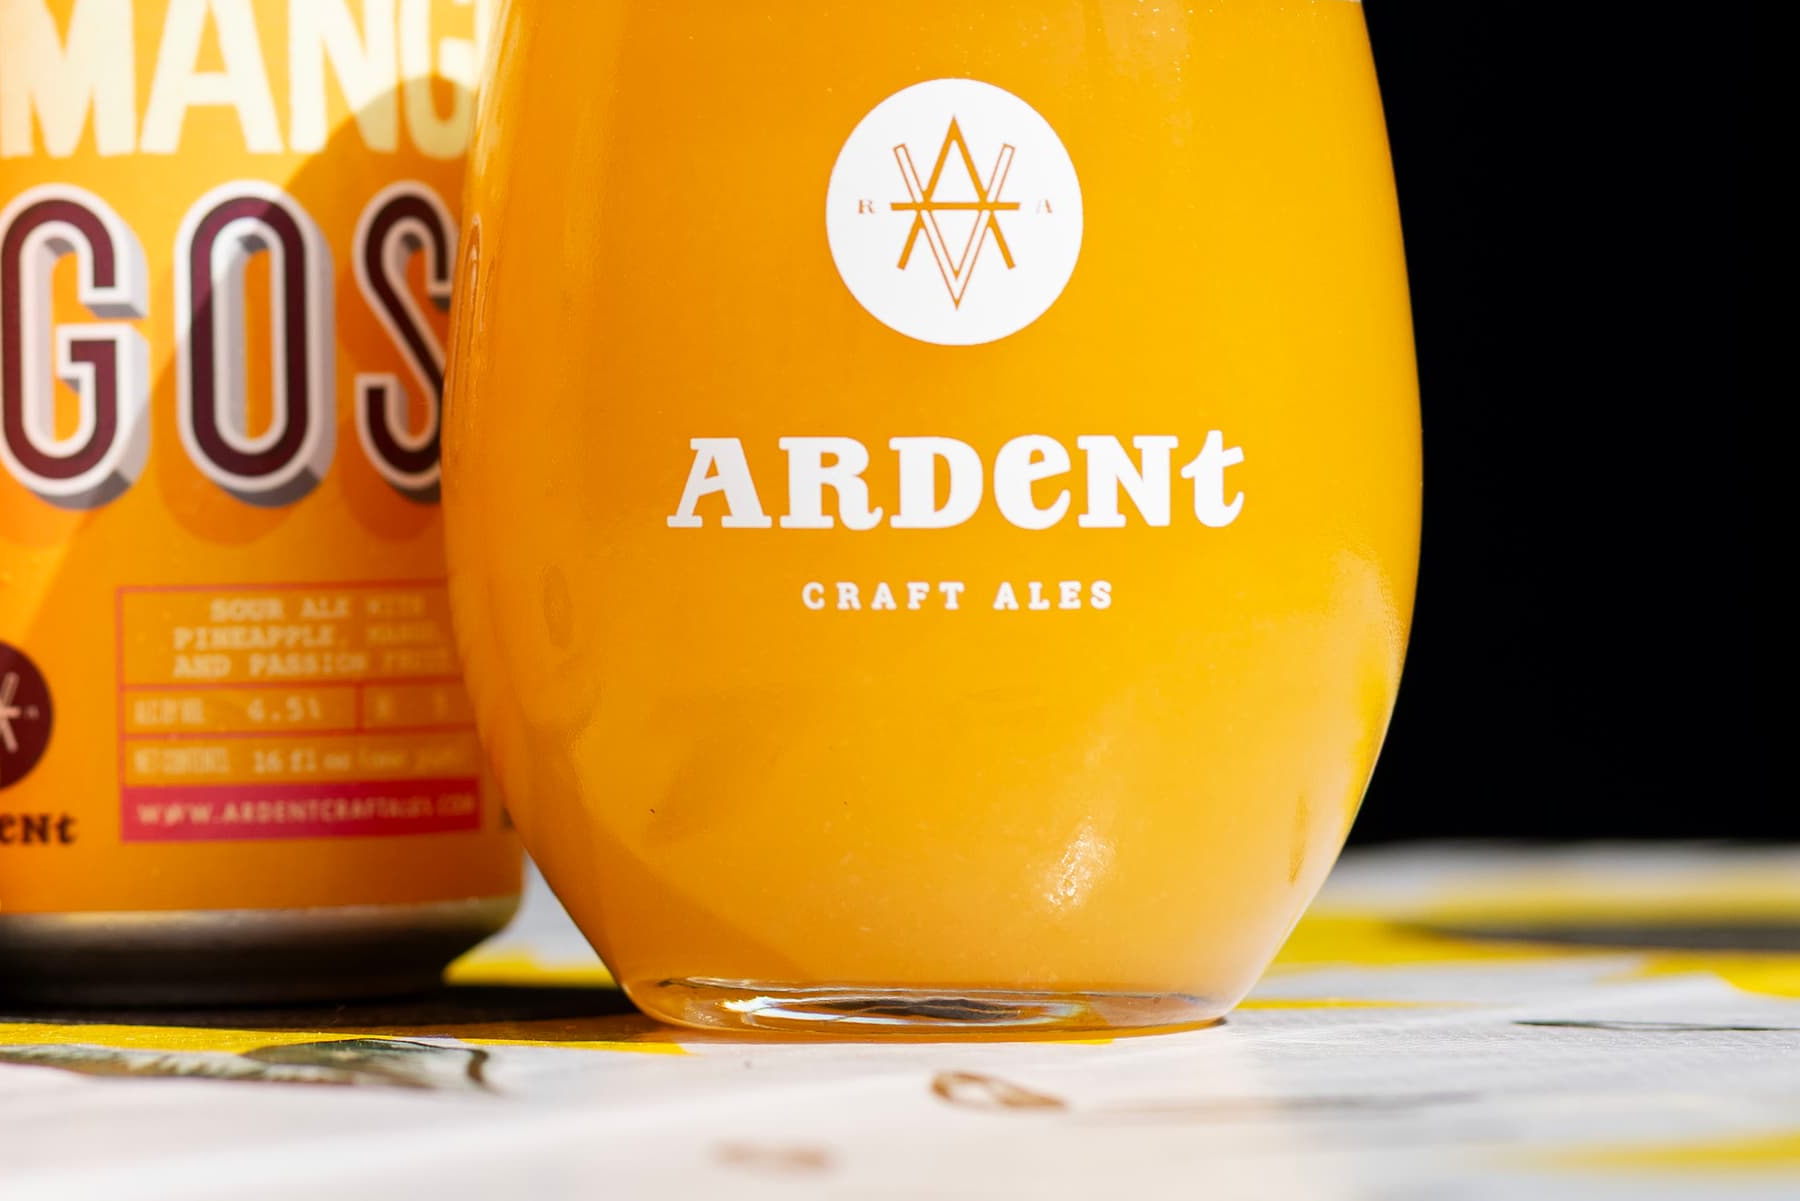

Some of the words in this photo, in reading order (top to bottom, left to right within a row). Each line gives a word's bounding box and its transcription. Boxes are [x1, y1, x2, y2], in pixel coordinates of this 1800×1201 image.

[802, 582, 965, 611] CRAFT
[993, 581, 1112, 611] ALES
[173, 654, 232, 679] AND
